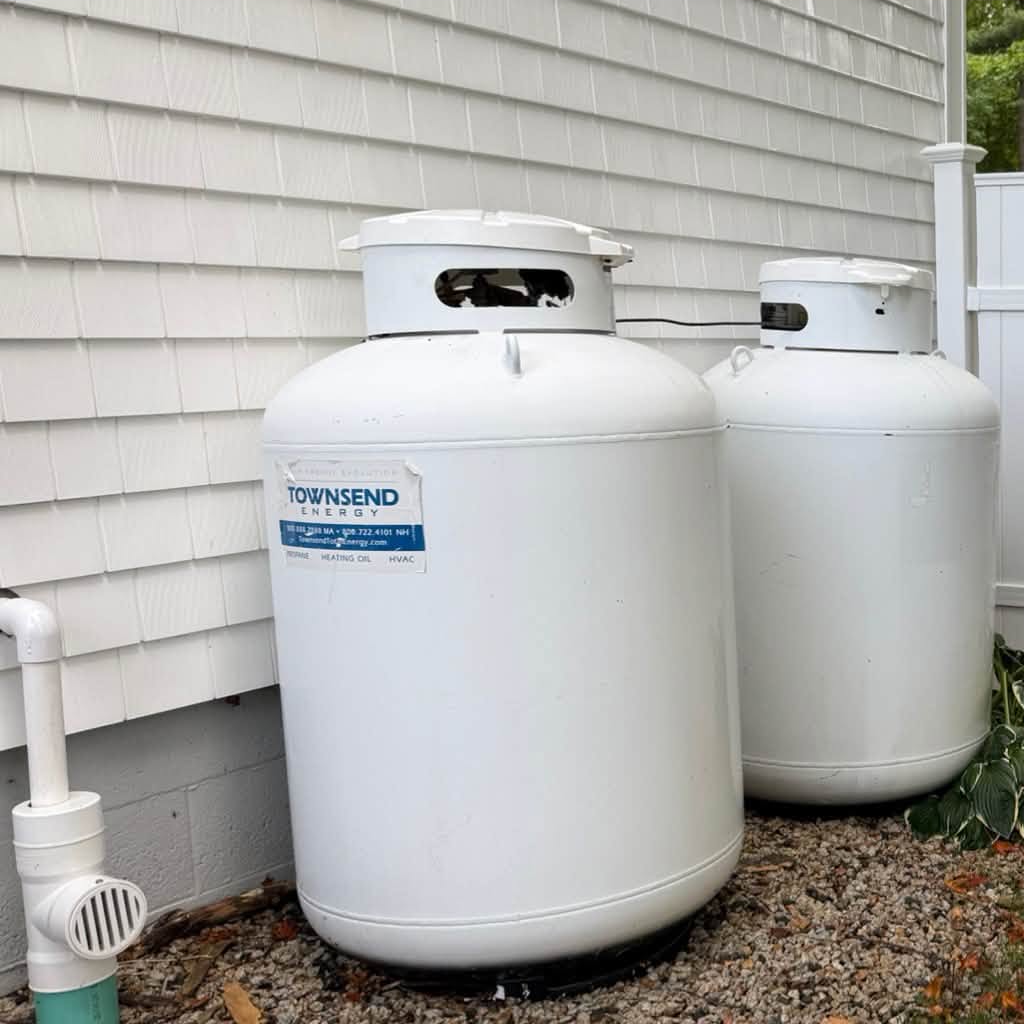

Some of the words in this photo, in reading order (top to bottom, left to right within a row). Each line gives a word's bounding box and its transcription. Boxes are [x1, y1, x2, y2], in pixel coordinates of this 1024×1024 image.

[288, 486, 400, 507] TOWNSEND
[301, 507, 378, 518] ENERGY
[323, 527, 335, 535] MA
[395, 529, 409, 537] NH
[321, 553, 354, 563] HEATING
[357, 554, 372, 563] OIL
[388, 555, 415, 564] HVAC
